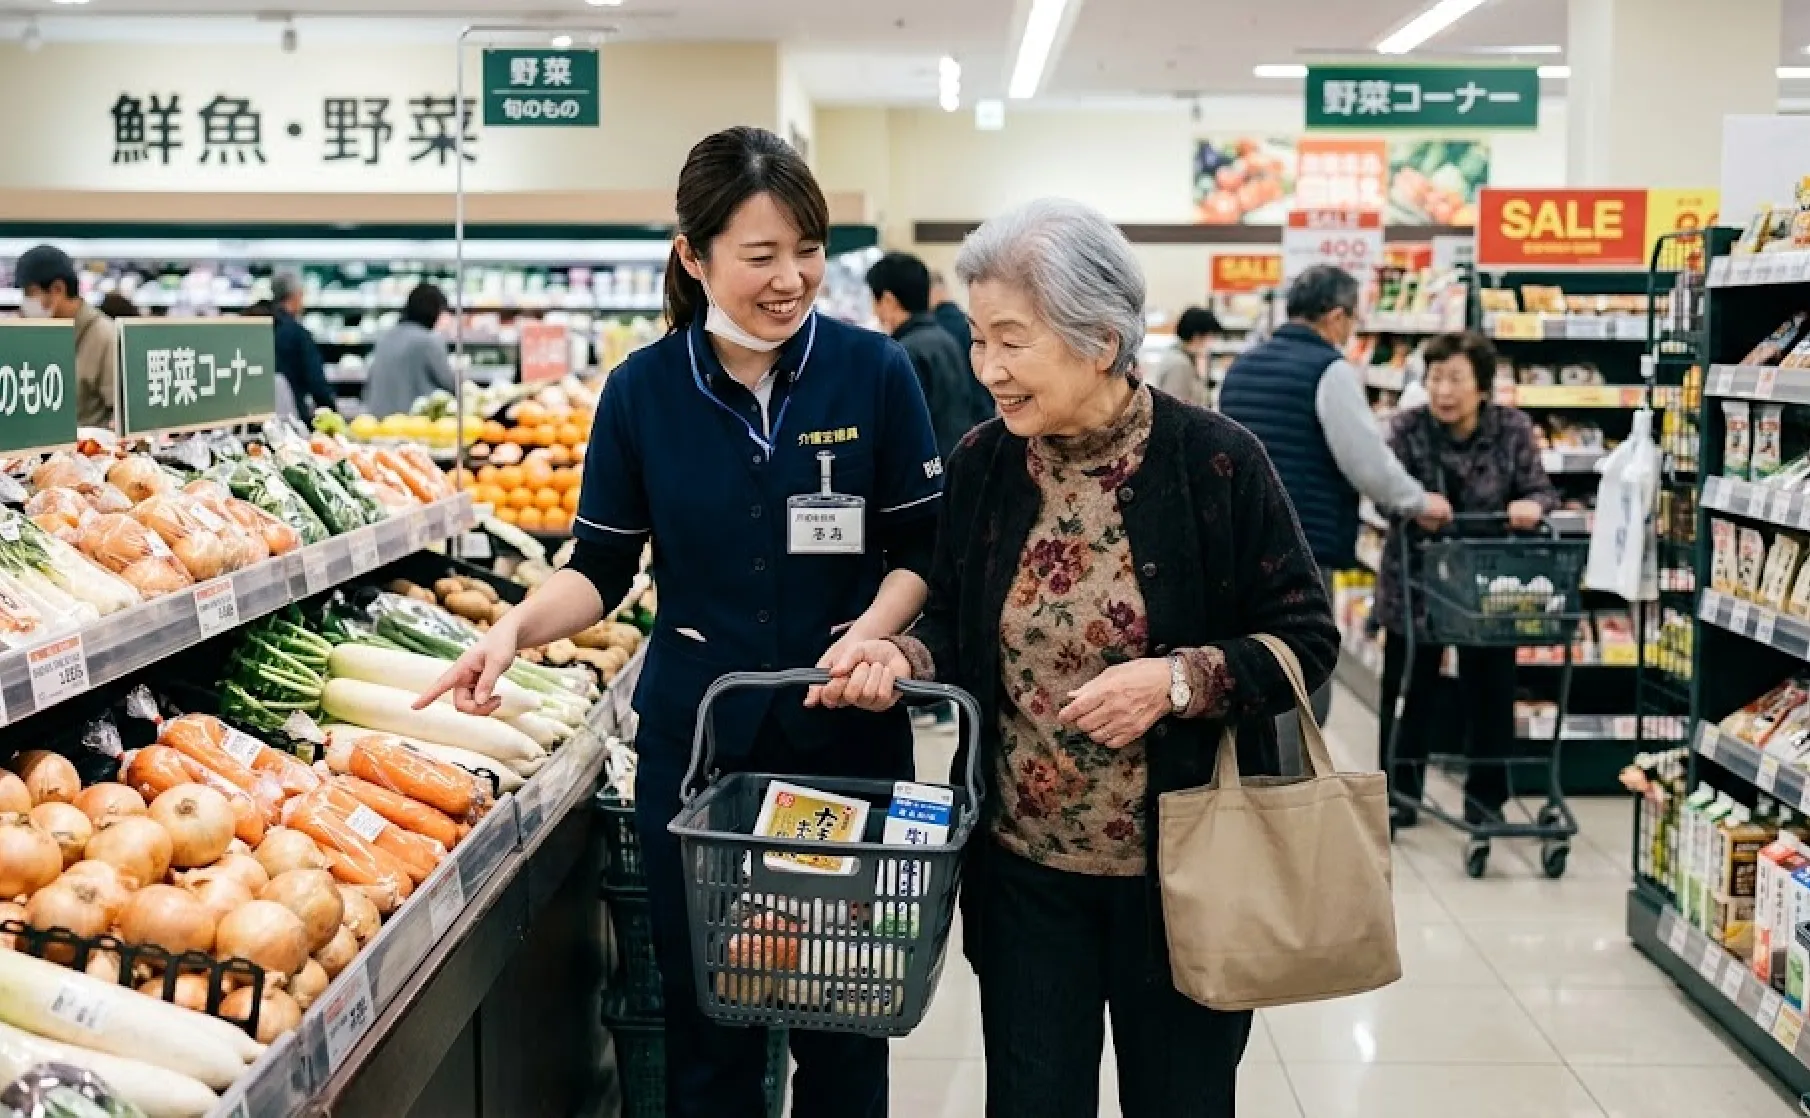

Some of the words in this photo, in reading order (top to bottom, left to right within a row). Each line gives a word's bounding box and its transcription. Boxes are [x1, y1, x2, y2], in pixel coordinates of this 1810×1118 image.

[510, 57, 572, 87] 野菜
[501, 97, 580, 119] 旬のもの
[1322, 79, 1521, 115] 野菜コーナー
[110, 92, 478, 165] 鮮魚・野菜
[1501, 199, 1625, 240] SALE
[1219, 257, 1281, 281] SALE
[146, 346, 265, 408] 野菜コーナー
